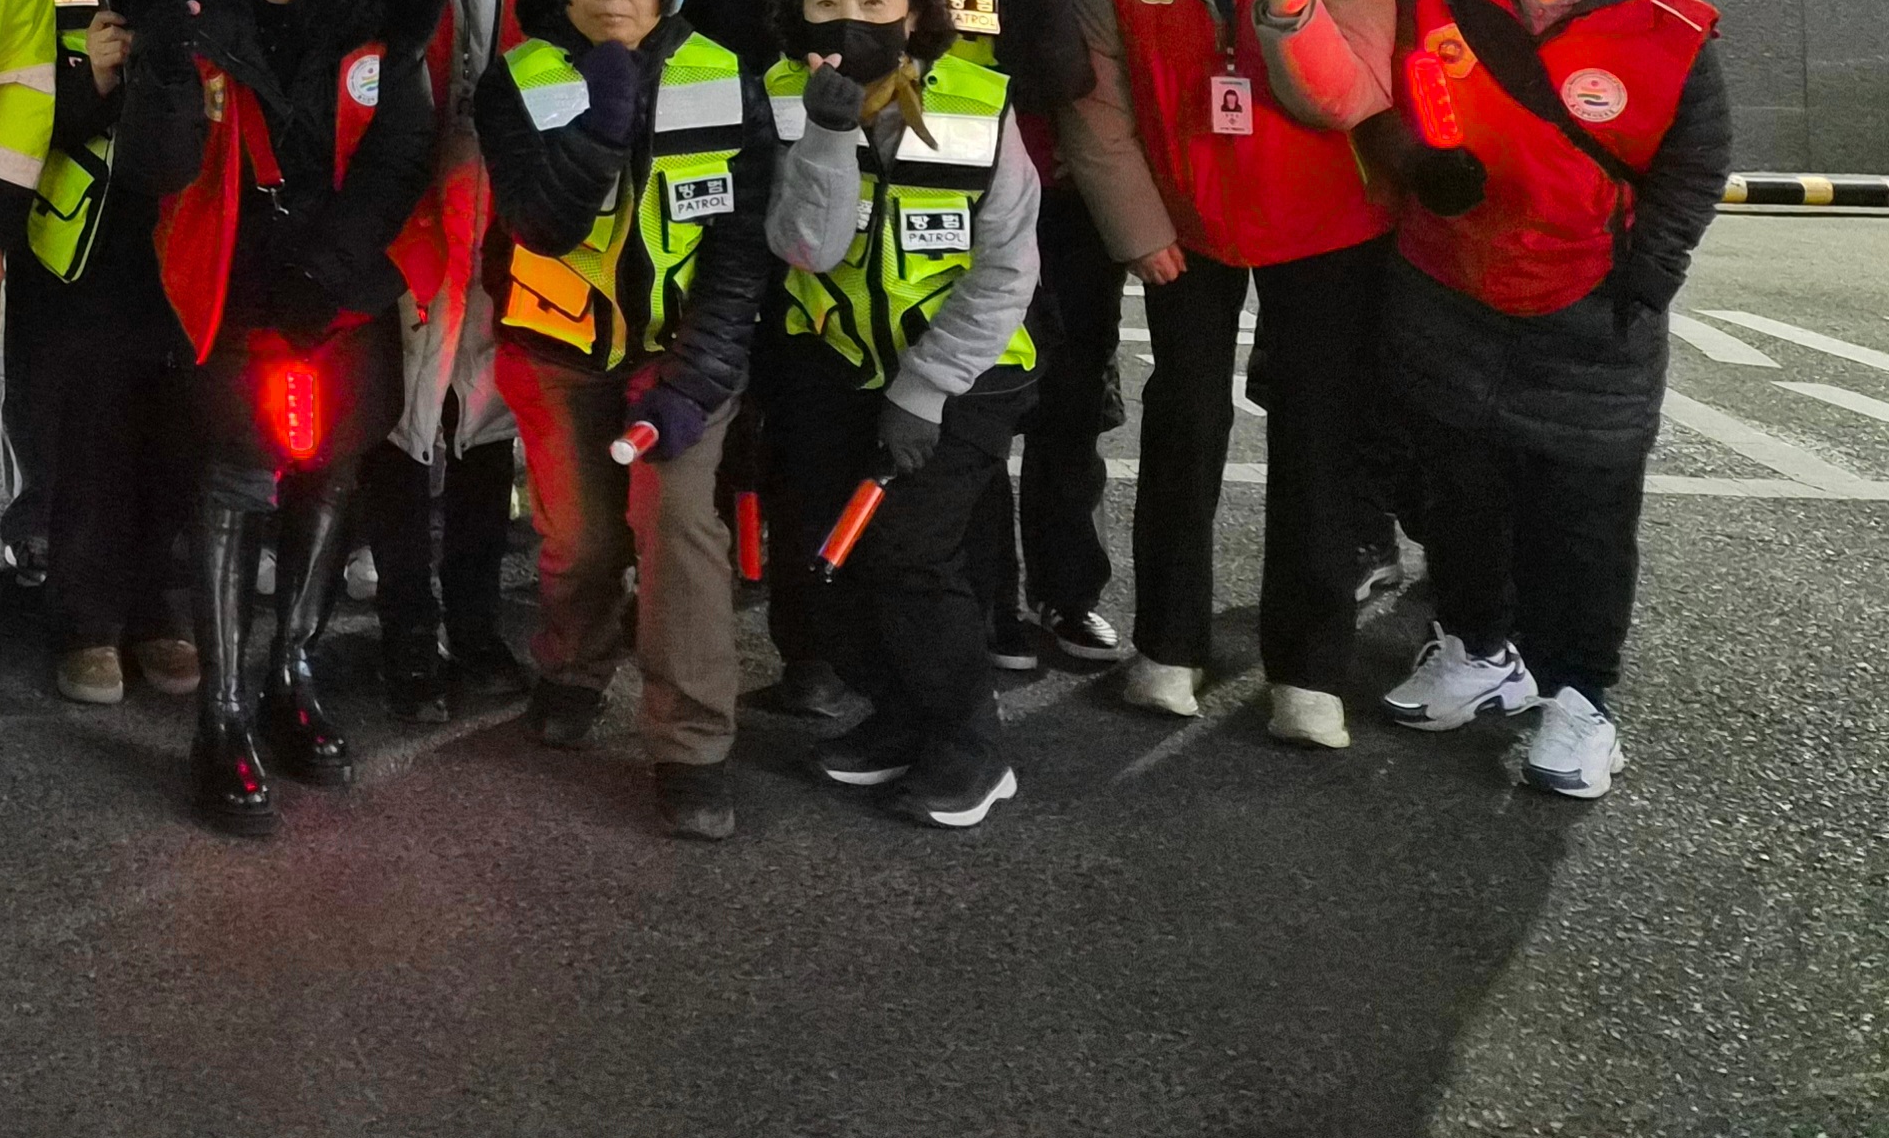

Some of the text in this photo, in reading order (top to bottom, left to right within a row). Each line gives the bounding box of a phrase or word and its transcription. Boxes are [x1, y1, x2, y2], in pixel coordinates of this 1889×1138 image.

[953, 13, 996, 27] ATROL
[677, 196, 728, 214] PATROL
[908, 231, 964, 243] PATROL
